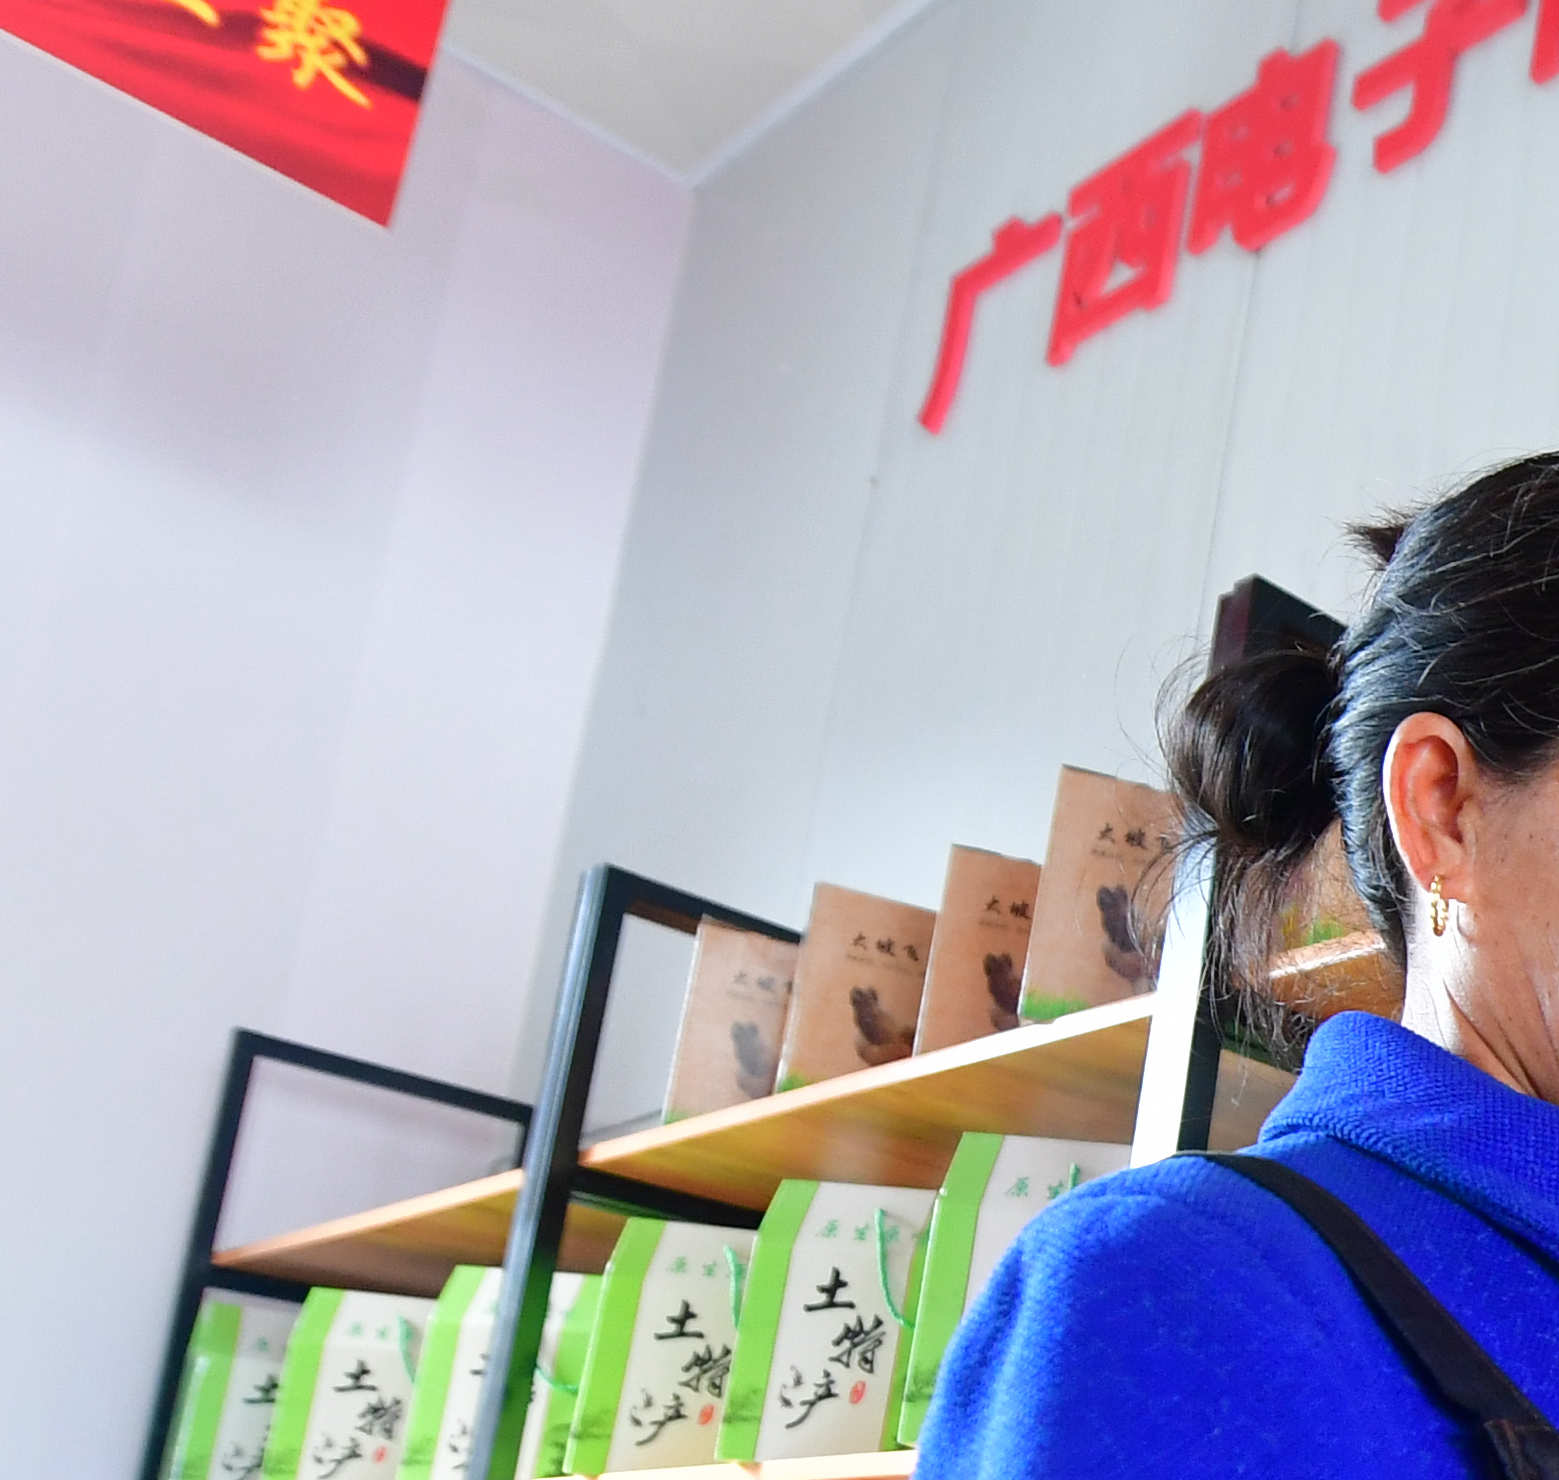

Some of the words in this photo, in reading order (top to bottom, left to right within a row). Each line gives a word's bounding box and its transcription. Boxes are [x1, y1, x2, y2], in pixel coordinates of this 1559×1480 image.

[630, 1299, 733, 1447] 土特产
[779, 1266, 887, 1430] 土特产
